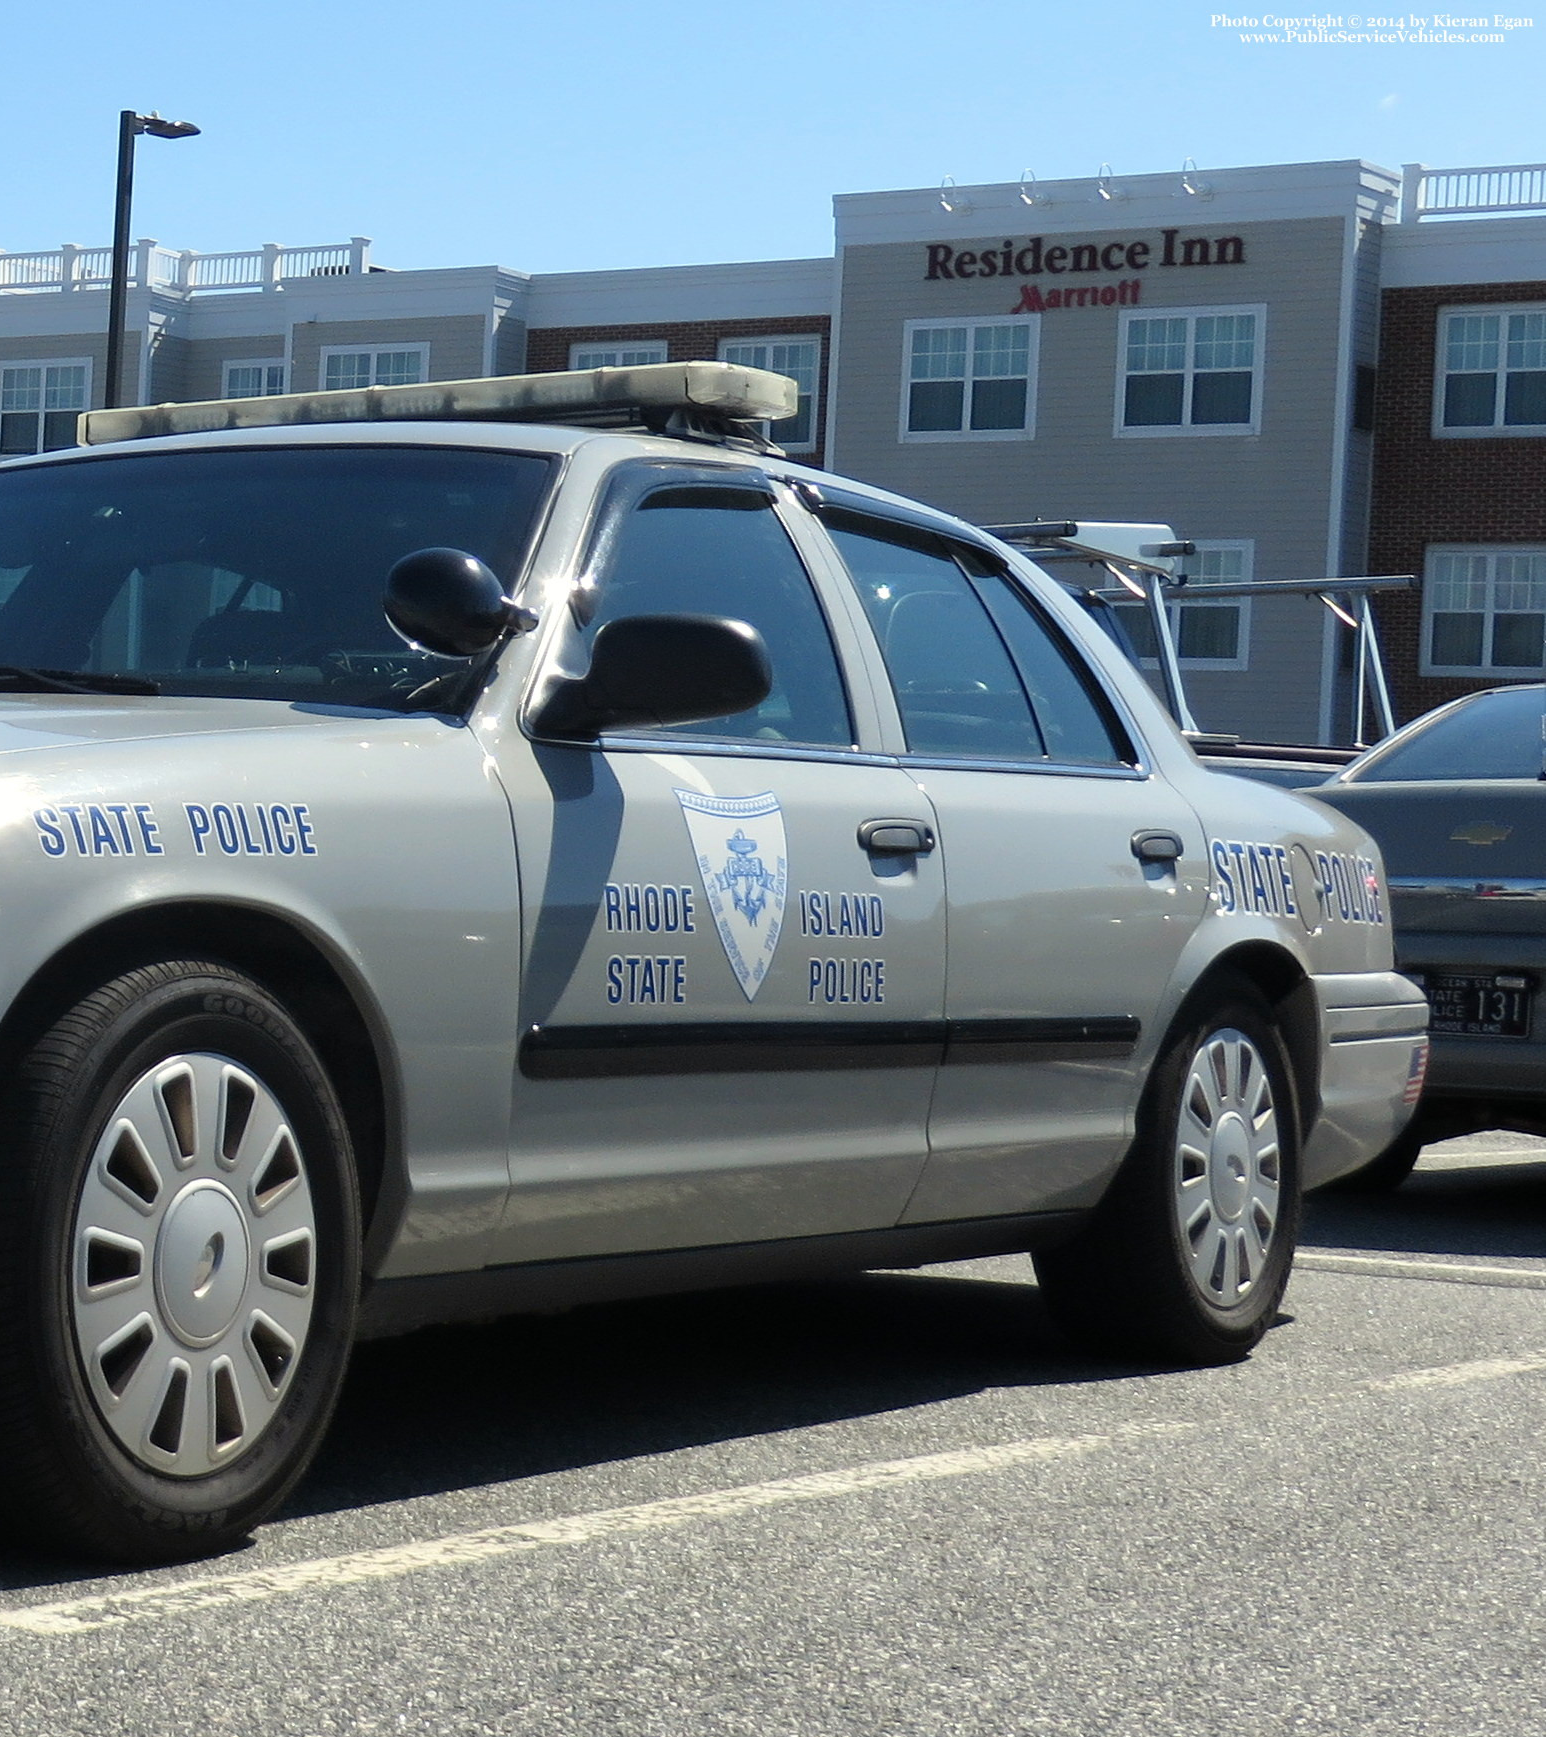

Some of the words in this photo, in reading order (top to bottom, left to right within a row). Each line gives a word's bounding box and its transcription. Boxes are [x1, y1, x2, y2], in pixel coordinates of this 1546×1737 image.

[924, 237, 1150, 280] Residence
[1159, 229, 1246, 267] Inn
[1010, 279, 1142, 315] Marriott
[32, 802, 165, 858] STATE
[182, 801, 318, 857] POLICE
[1210, 838, 1297, 919] STATE
[1315, 850, 1383, 926] POLICE
[604, 883, 696, 933] RHODE
[799, 890, 884, 939] ISLAND
[606, 954, 687, 1005] STATE
[808, 957, 885, 1004] POLICE
[1429, 989, 1464, 1003] TATE
[1432, 1004, 1465, 1018] LICE
[1478, 990, 1521, 1022] 131
